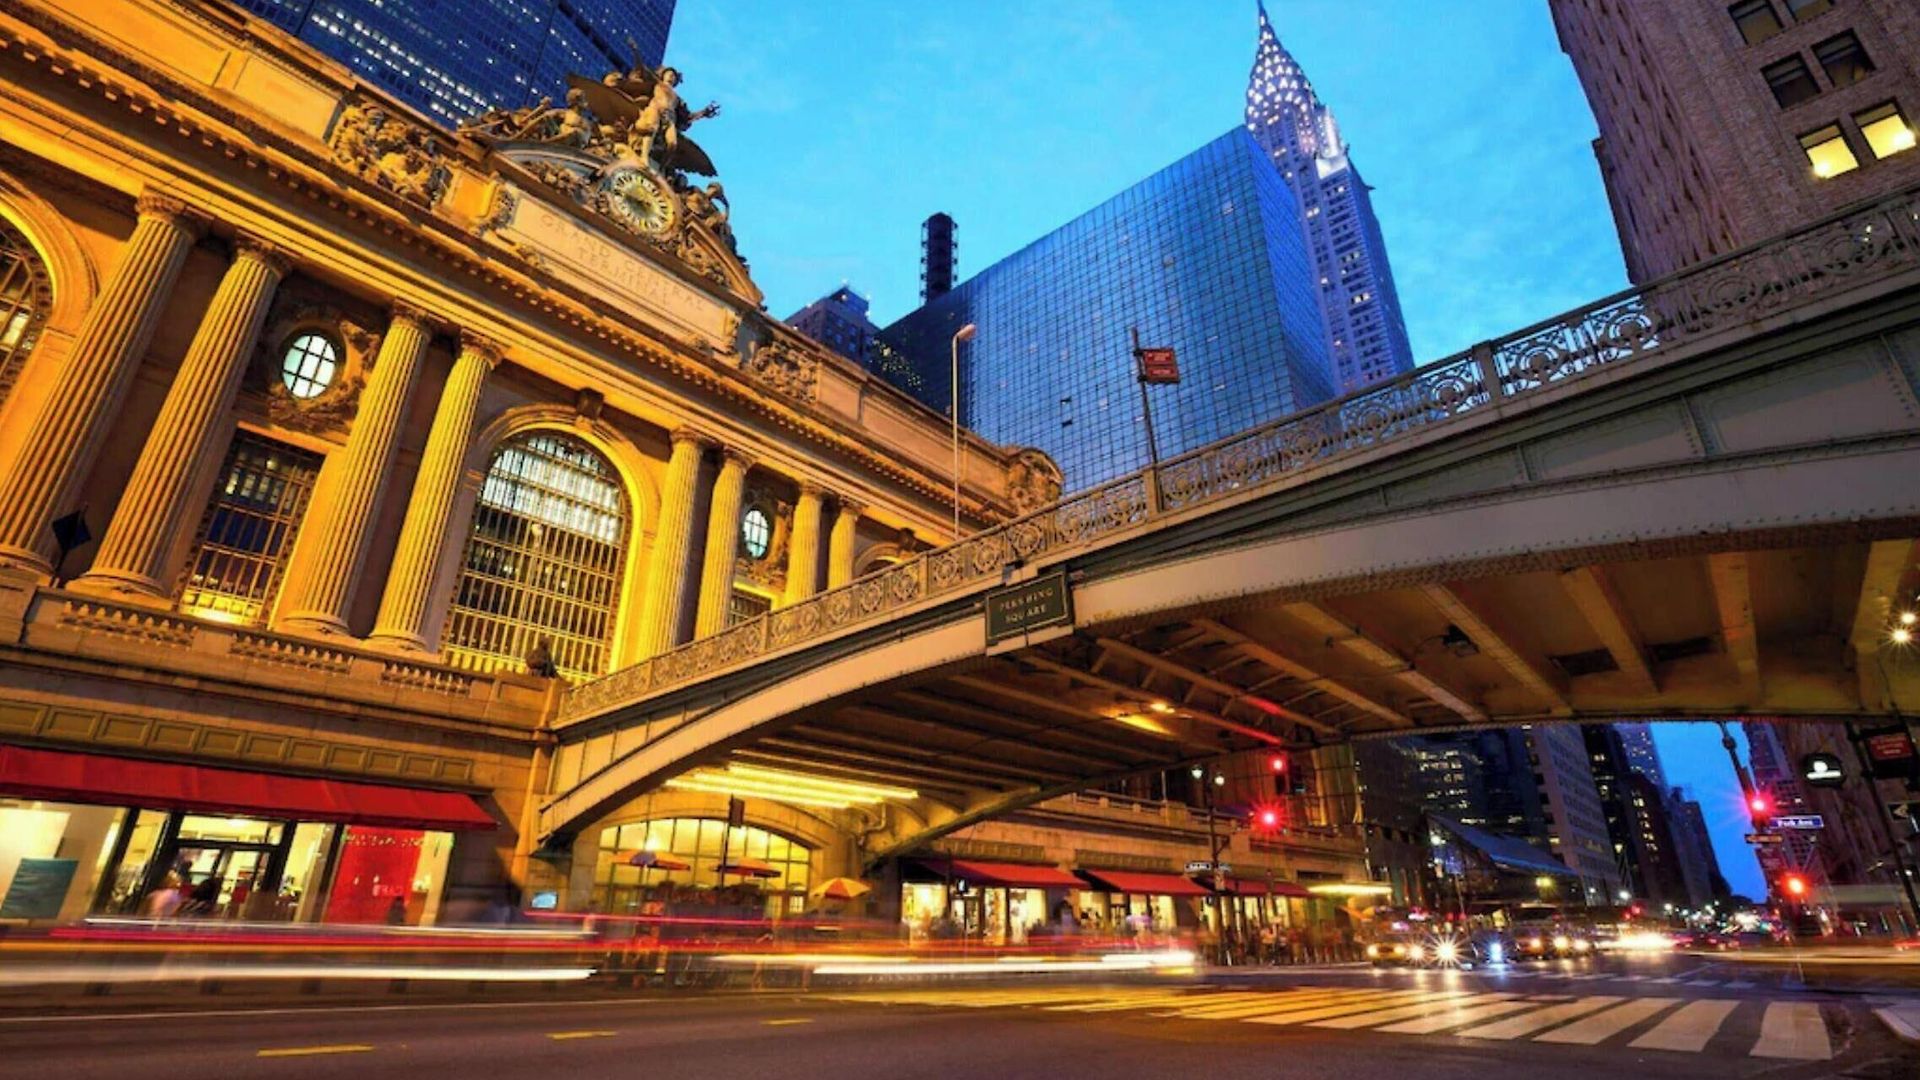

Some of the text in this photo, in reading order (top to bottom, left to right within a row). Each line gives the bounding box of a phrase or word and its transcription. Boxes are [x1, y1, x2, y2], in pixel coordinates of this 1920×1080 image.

[540, 213, 704, 312] GRAND CENTRAL
[577, 246, 672, 305] TERMINAL
[1001, 588, 1053, 611] PERSHING
[1006, 604, 1046, 623] SQUARE
